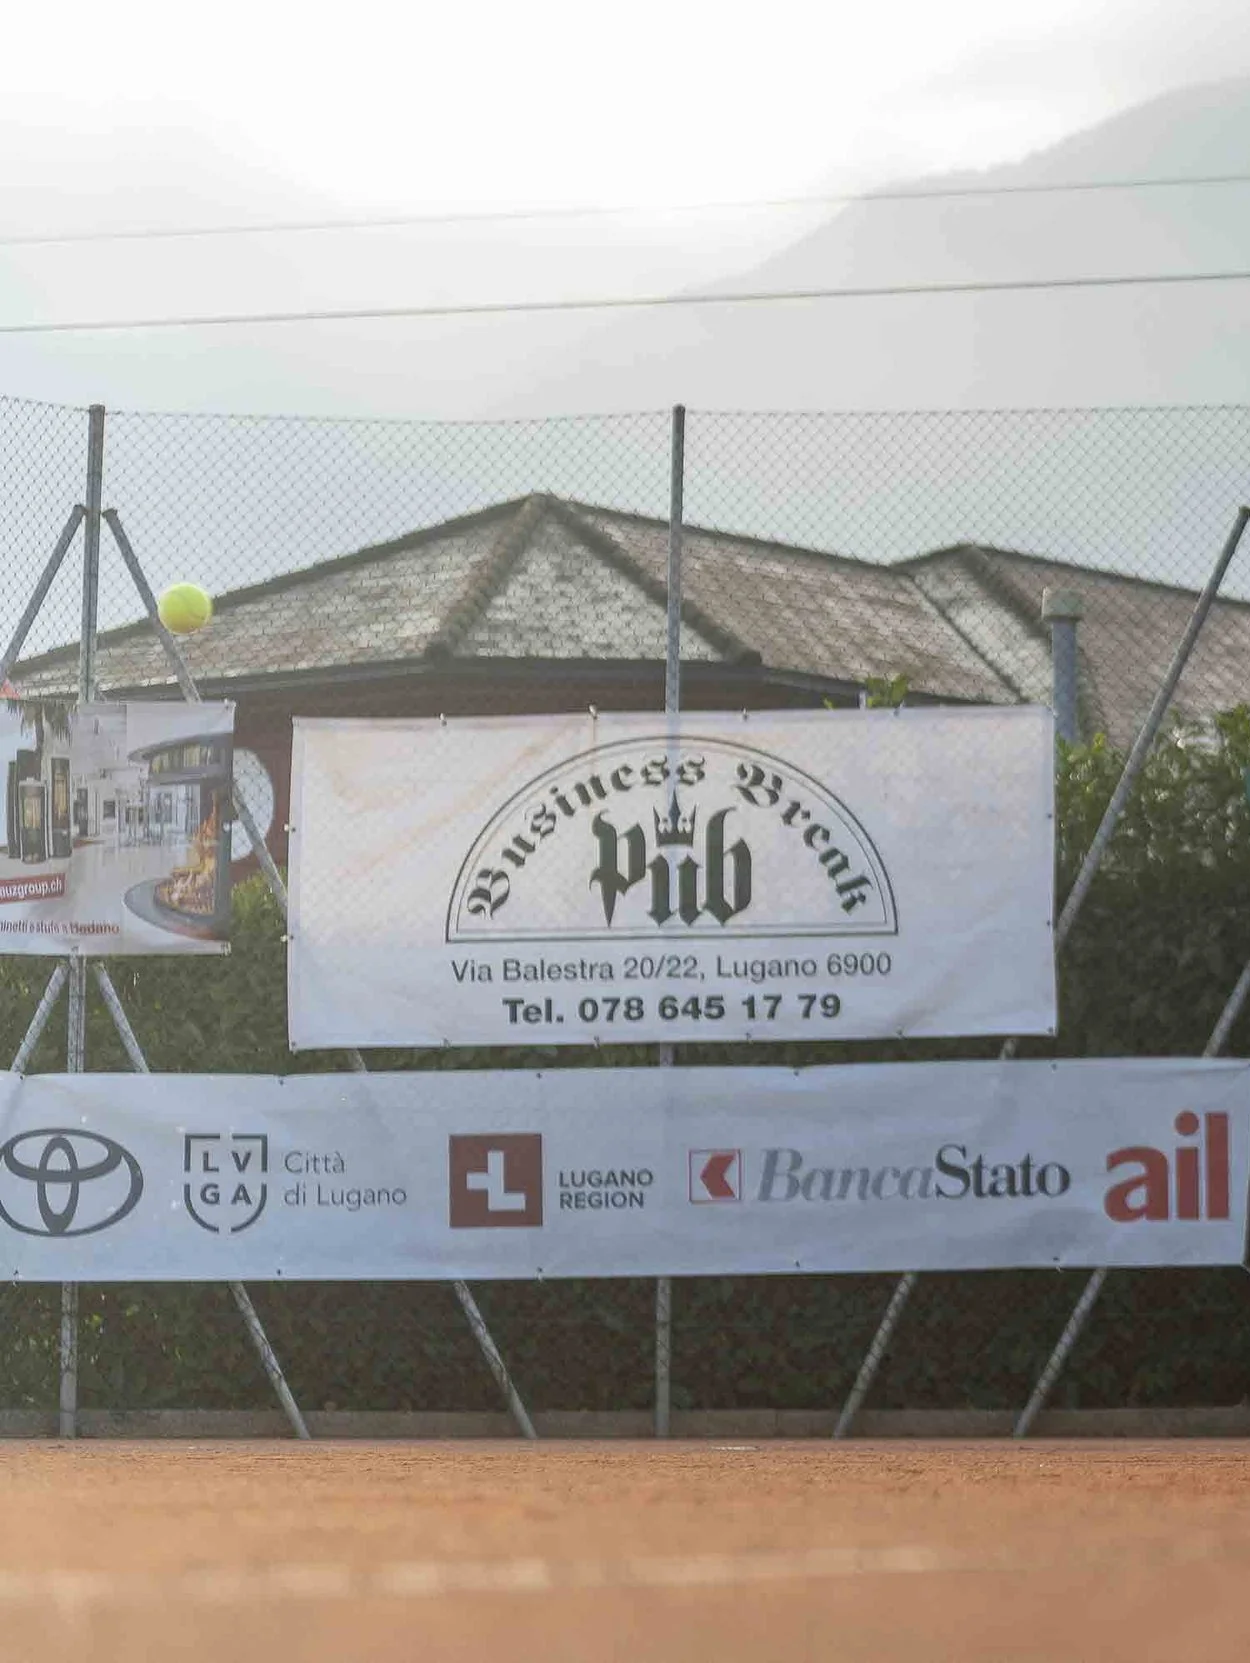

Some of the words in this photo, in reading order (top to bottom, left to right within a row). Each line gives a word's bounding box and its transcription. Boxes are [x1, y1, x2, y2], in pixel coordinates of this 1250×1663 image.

[465, 755, 707, 919] Business
[736, 762, 874, 914] Break
[588, 807, 753, 928] Pub
[450, 959, 493, 983] Via
[502, 957, 615, 983] Balestra
[623, 955, 706, 982] 20/22,
[716, 954, 818, 984] Lugano
[827, 952, 892, 977] 6900
[502, 998, 566, 1025] Tel.
[578, 997, 646, 1024] 078
[657, 995, 726, 1021] 645
[742, 994, 783, 1020] 17
[798, 993, 842, 1019] 79
[284, 1150, 345, 1175] Città
[559, 1168, 654, 1189] LUGANO
[757, 1143, 1071, 1202] BancaStato
[1103, 1110, 1230, 1222] ail
[284, 1182, 306, 1206] di
[317, 1183, 408, 1212] Lugano
[560, 1190, 645, 1210] REGION
